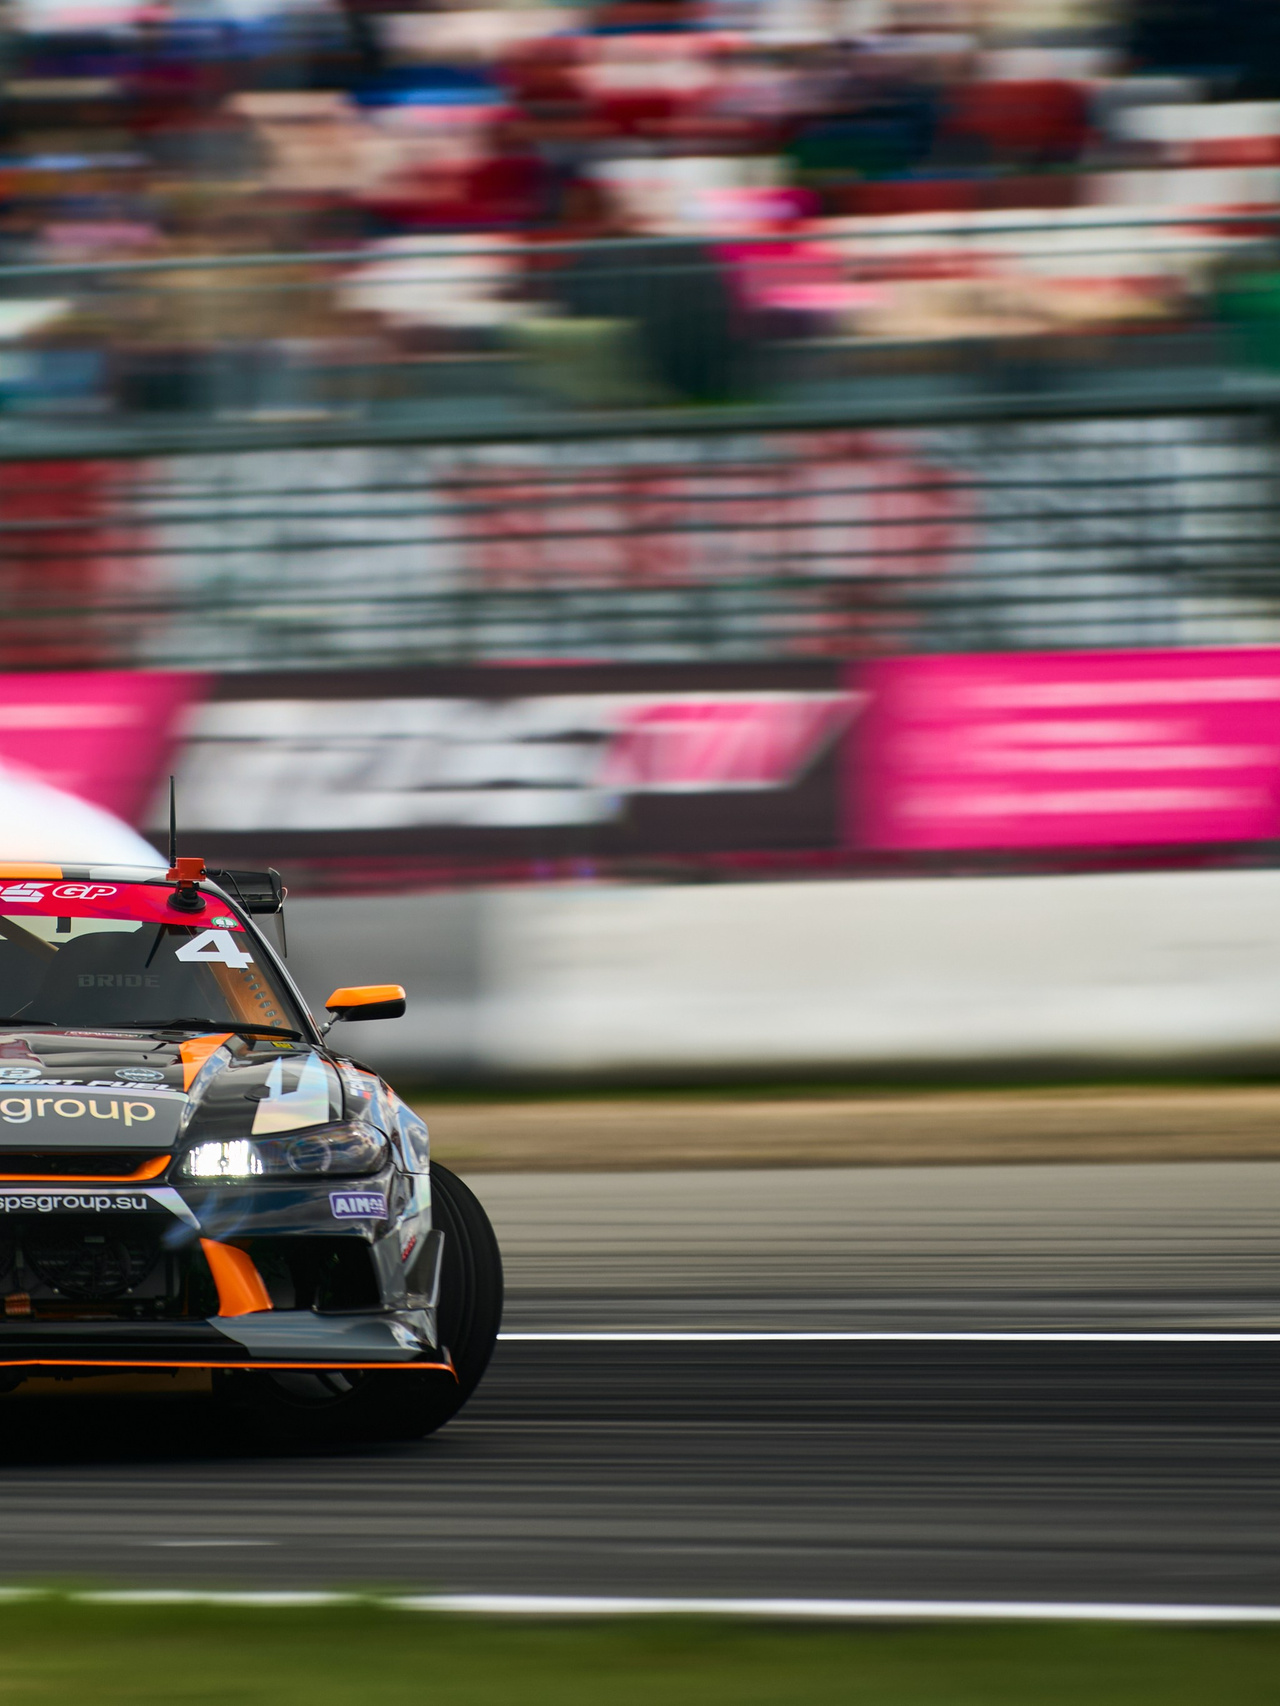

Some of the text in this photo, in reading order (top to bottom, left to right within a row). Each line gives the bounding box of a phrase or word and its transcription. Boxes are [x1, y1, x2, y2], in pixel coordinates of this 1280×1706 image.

[52, 884, 117, 900] GP
[175, 929, 255, 969] 4
[77, 974, 160, 988] BRIDE
[86, 1080, 177, 1091] FUEL
